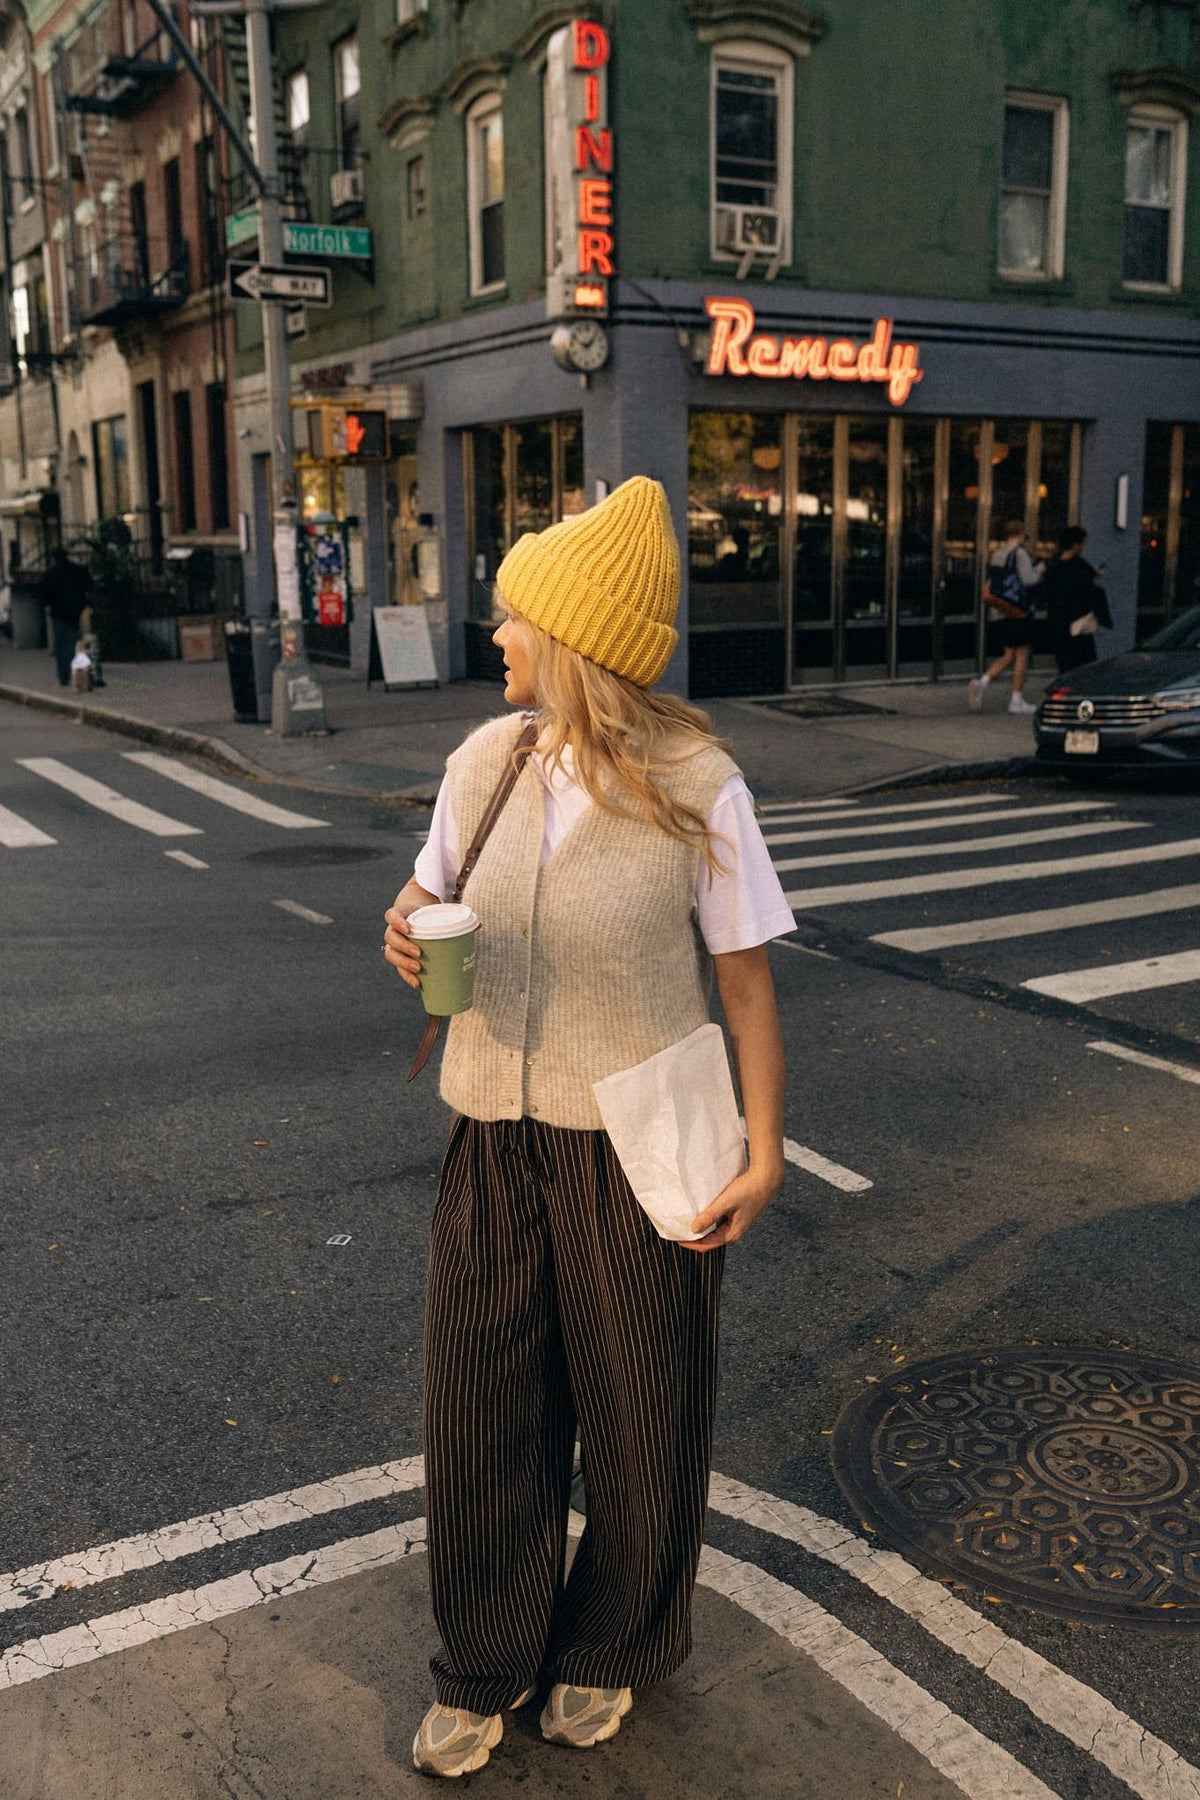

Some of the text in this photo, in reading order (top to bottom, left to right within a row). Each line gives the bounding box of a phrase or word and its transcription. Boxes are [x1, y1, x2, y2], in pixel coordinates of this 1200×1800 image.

[573, 20, 615, 276] DINER
[284, 225, 351, 253] Norfolk
[248, 274, 316, 292] ONE WAY
[703, 295, 924, 407] Remedy
